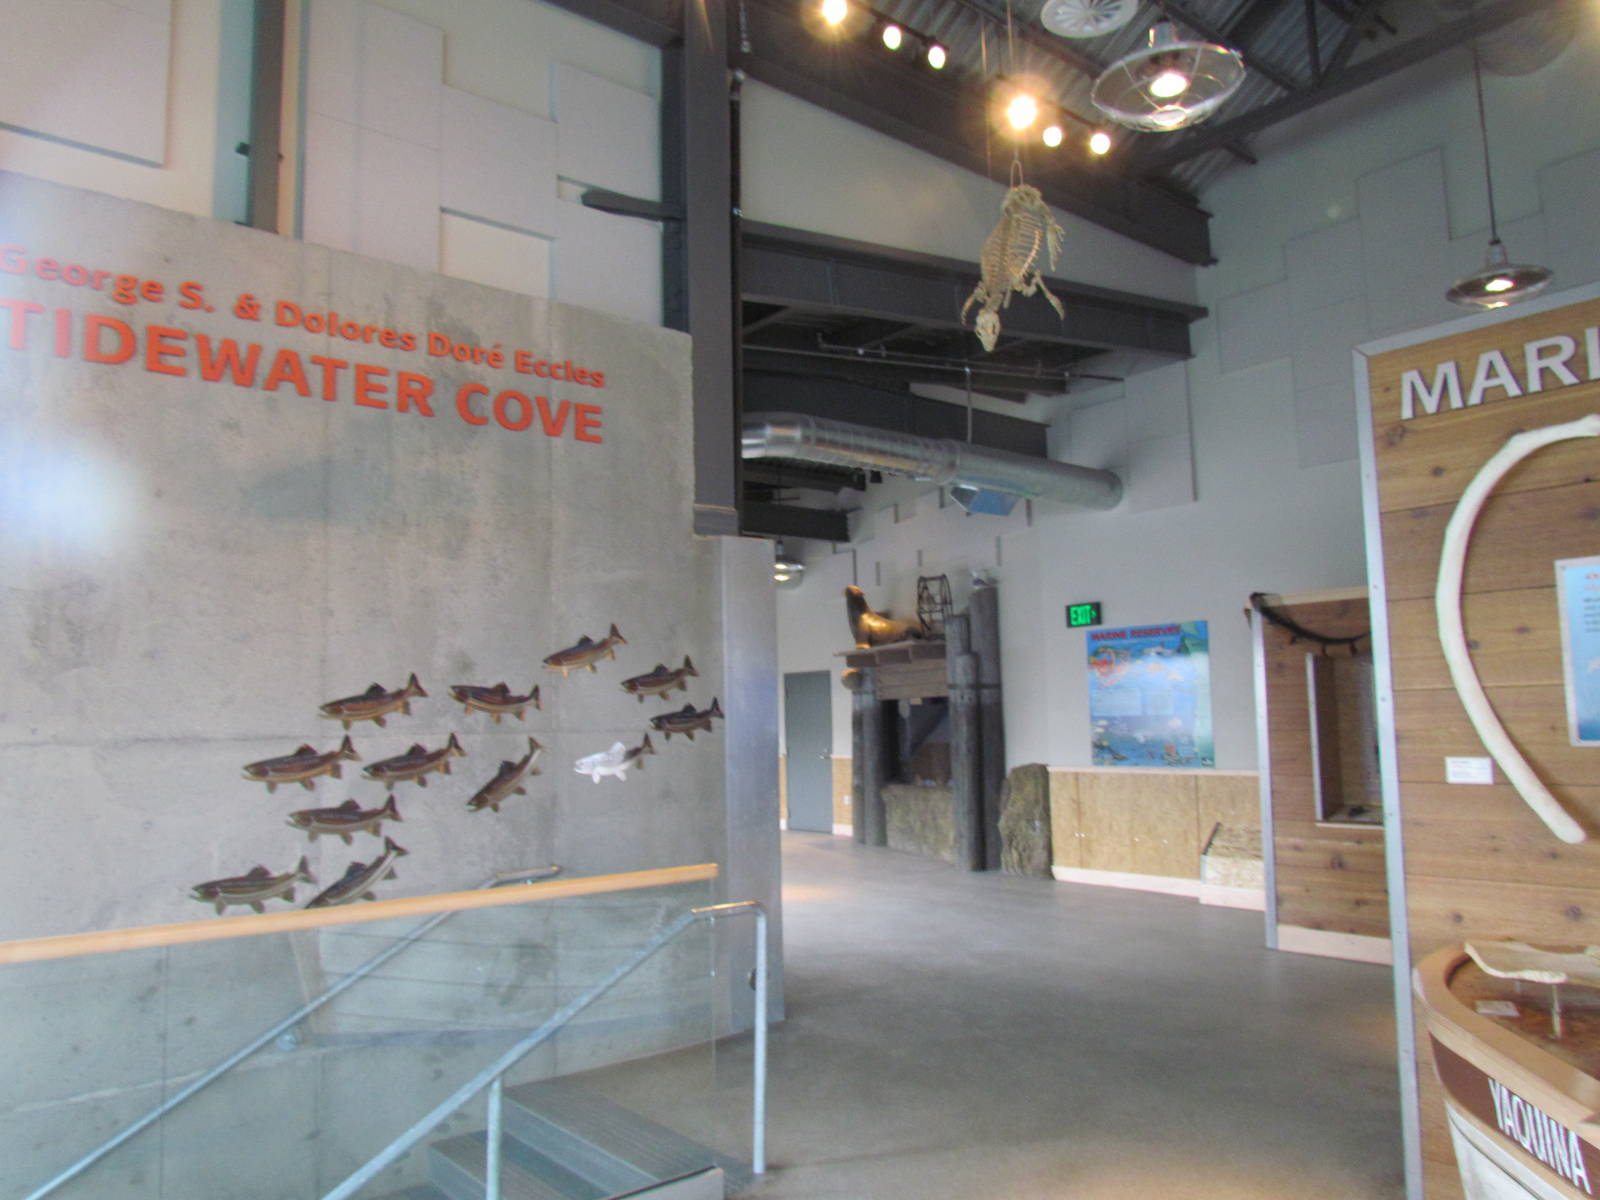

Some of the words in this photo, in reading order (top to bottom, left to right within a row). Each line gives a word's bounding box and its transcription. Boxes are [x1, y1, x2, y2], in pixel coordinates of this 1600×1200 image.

[0, 244, 164, 304] George
[179, 282, 214, 311] S.
[234, 294, 262, 321] &
[276, 301, 417, 351] Dolores
[428, 331, 504, 368] Doré
[514, 352, 605, 388] Eccles
[0, 299, 435, 417] TIDEWATER
[456, 383, 605, 443] COVE
[1070, 604, 1091, 626] EXIT
[1092, 632, 1126, 641] MARINE
[1488, 1077, 1592, 1195] YAQUINA
